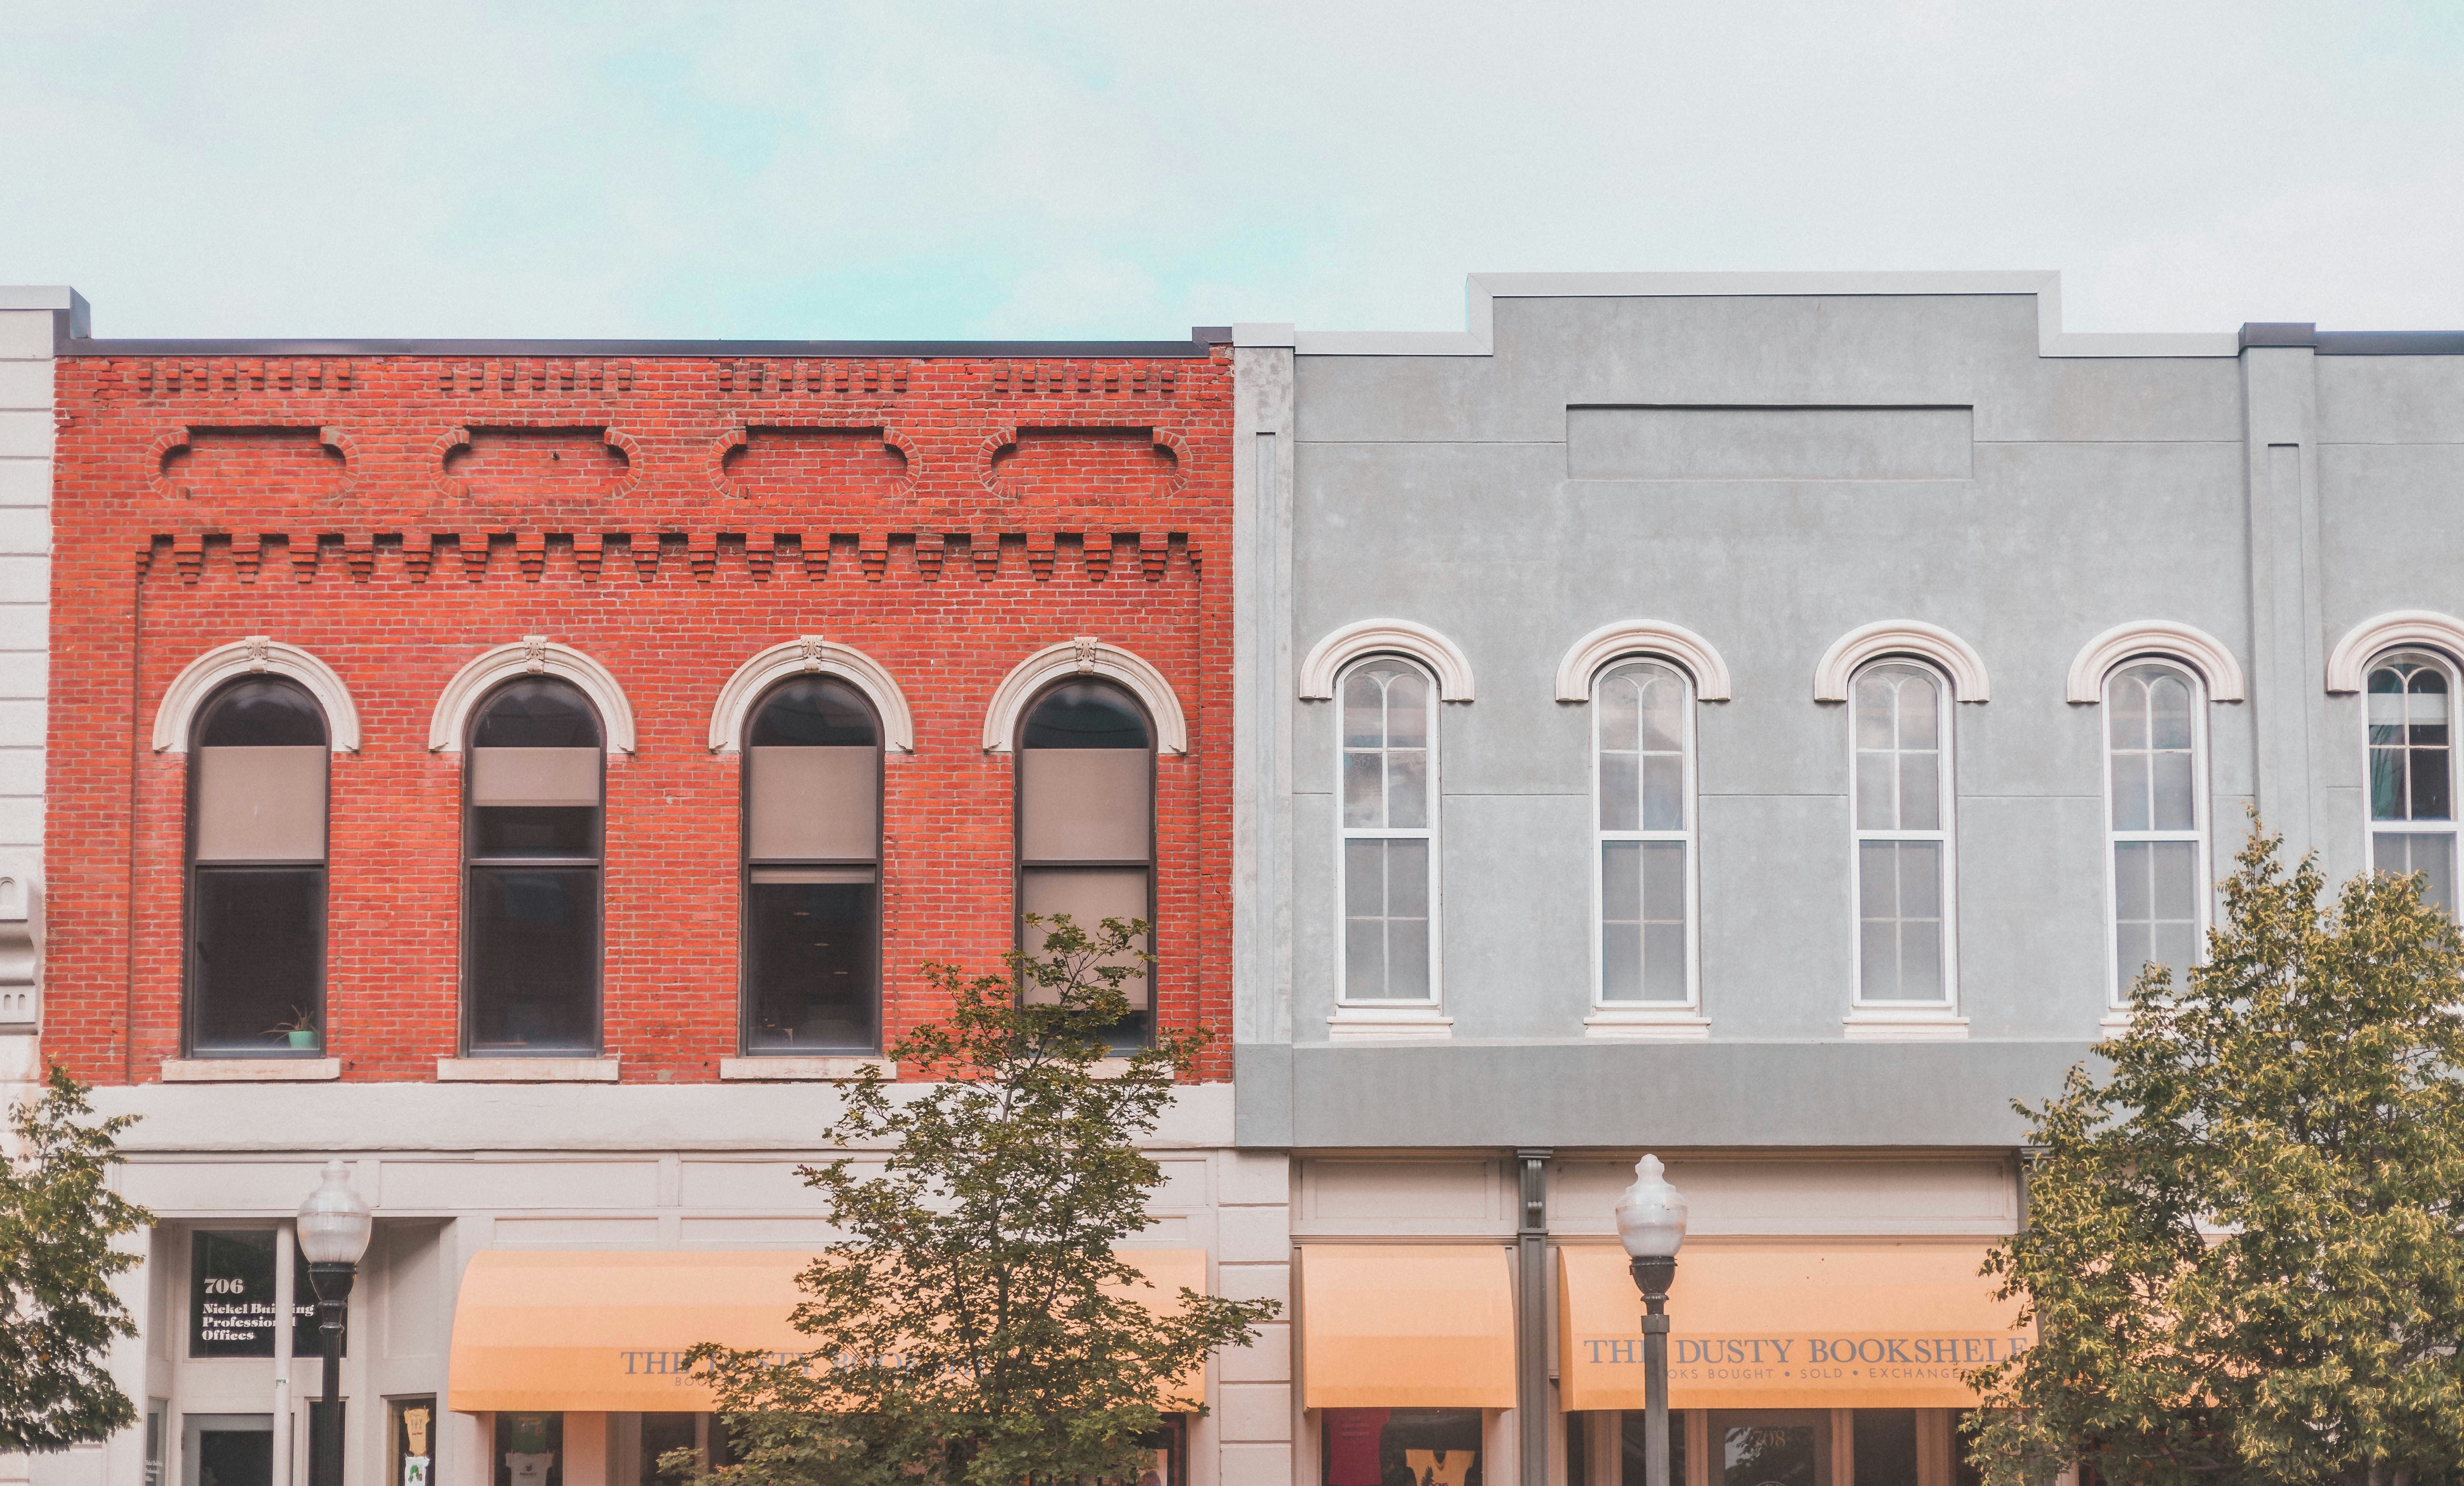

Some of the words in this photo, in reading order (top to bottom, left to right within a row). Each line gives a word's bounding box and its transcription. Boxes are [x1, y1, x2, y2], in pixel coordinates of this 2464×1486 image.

[204, 1278, 244, 1294] 706
[203, 1304, 247, 1314] Nickel
[251, 1303, 314, 1317] Buiing
[202, 1316, 296, 1327] Professiol
[202, 1330, 254, 1340] Offices
[1675, 1339, 1794, 1364] DUSTY
[1808, 1338, 2027, 1363] BOOKSHELF
[1667, 1369, 1698, 1379] OKS
[1708, 1369, 1773, 1379] BOUGHT
[1801, 1368, 1842, 1379] SOLD
[675, 1377, 726, 1386] BOO
[1754, 1429, 1785, 1448] 708
